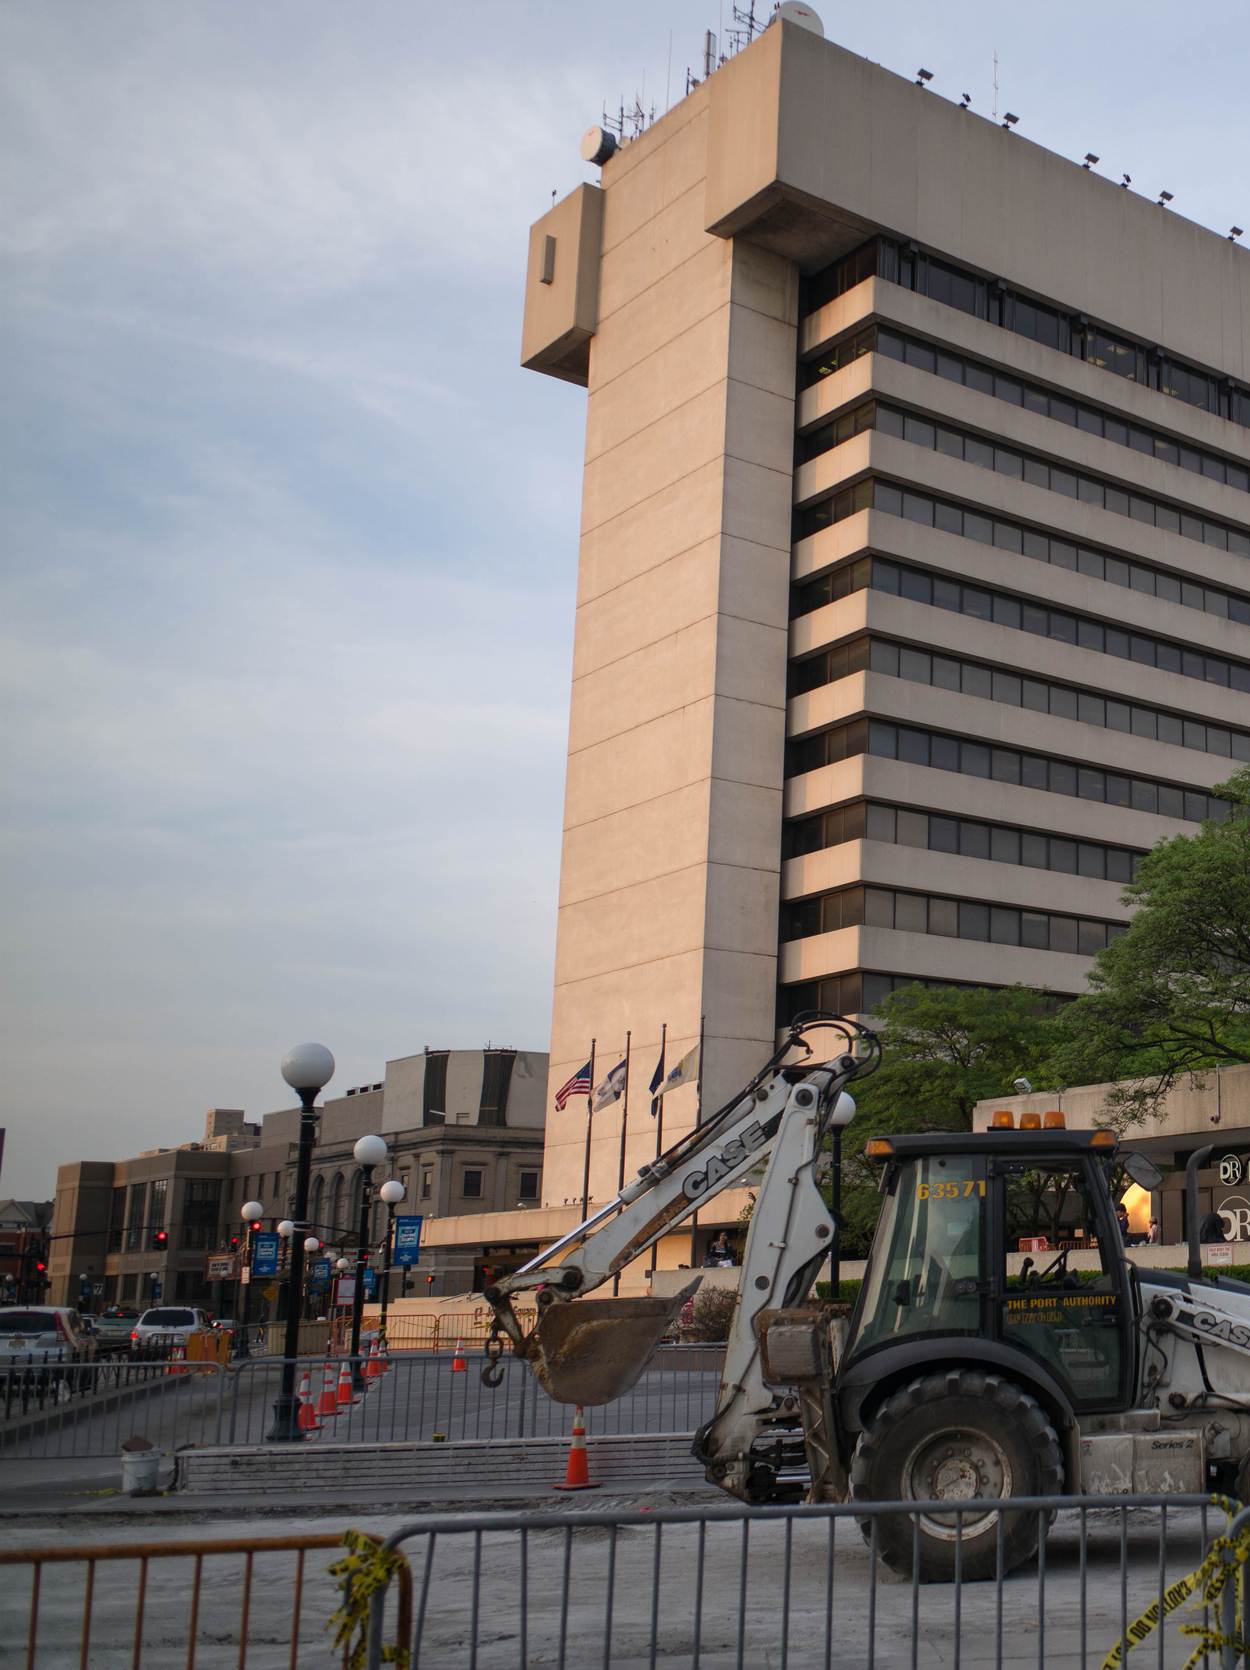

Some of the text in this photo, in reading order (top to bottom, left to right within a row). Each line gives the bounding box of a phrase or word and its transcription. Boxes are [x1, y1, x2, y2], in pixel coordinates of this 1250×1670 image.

[682, 1120, 767, 1199] CASE
[917, 1180, 986, 1200] 63571
[1007, 1295, 1116, 1310] THE PORT AUTHORITY
[1151, 1439, 1194, 1450] Series 2
